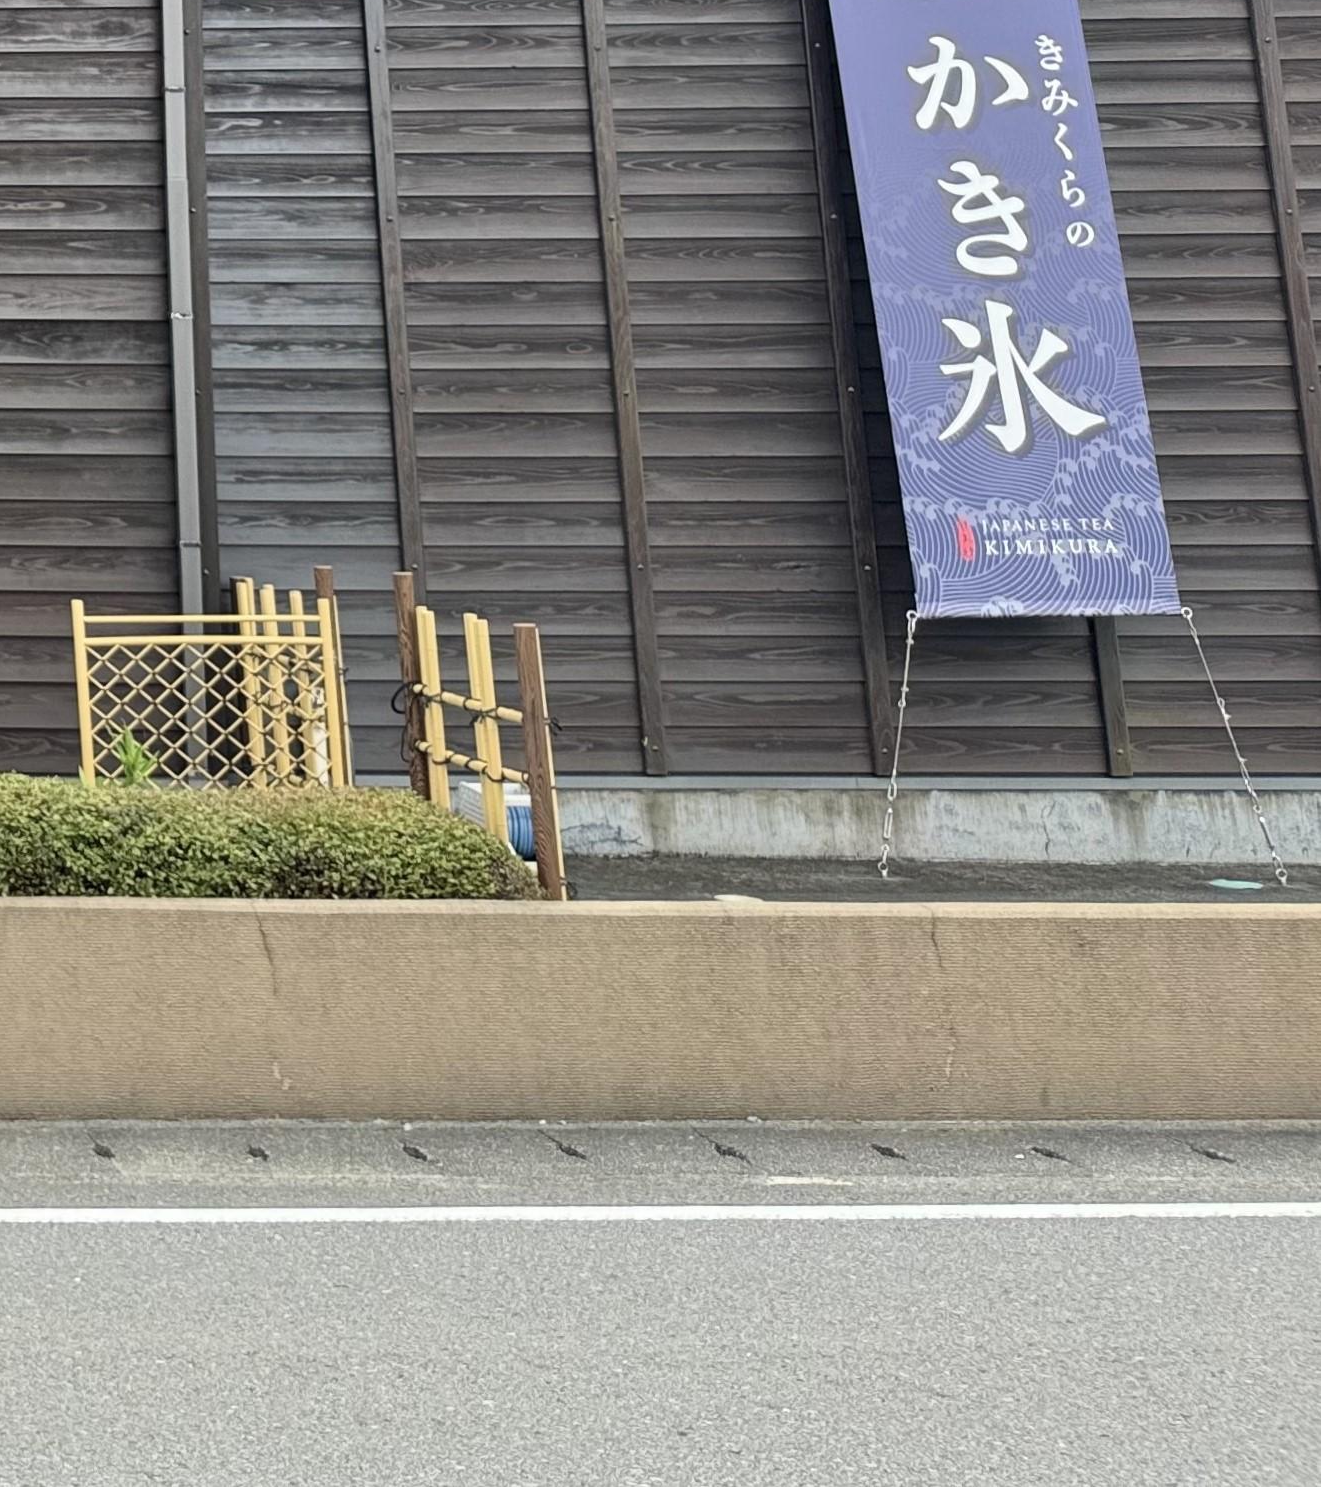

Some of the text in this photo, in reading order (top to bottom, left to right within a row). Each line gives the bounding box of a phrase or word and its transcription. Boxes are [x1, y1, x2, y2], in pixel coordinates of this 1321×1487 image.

[1034, 34, 1095, 248] きみくらの
[907, 35, 1107, 453] かき氷
[981, 516, 1116, 534] JAPANESE TEA
[984, 537, 1119, 556] KIMIKURA
